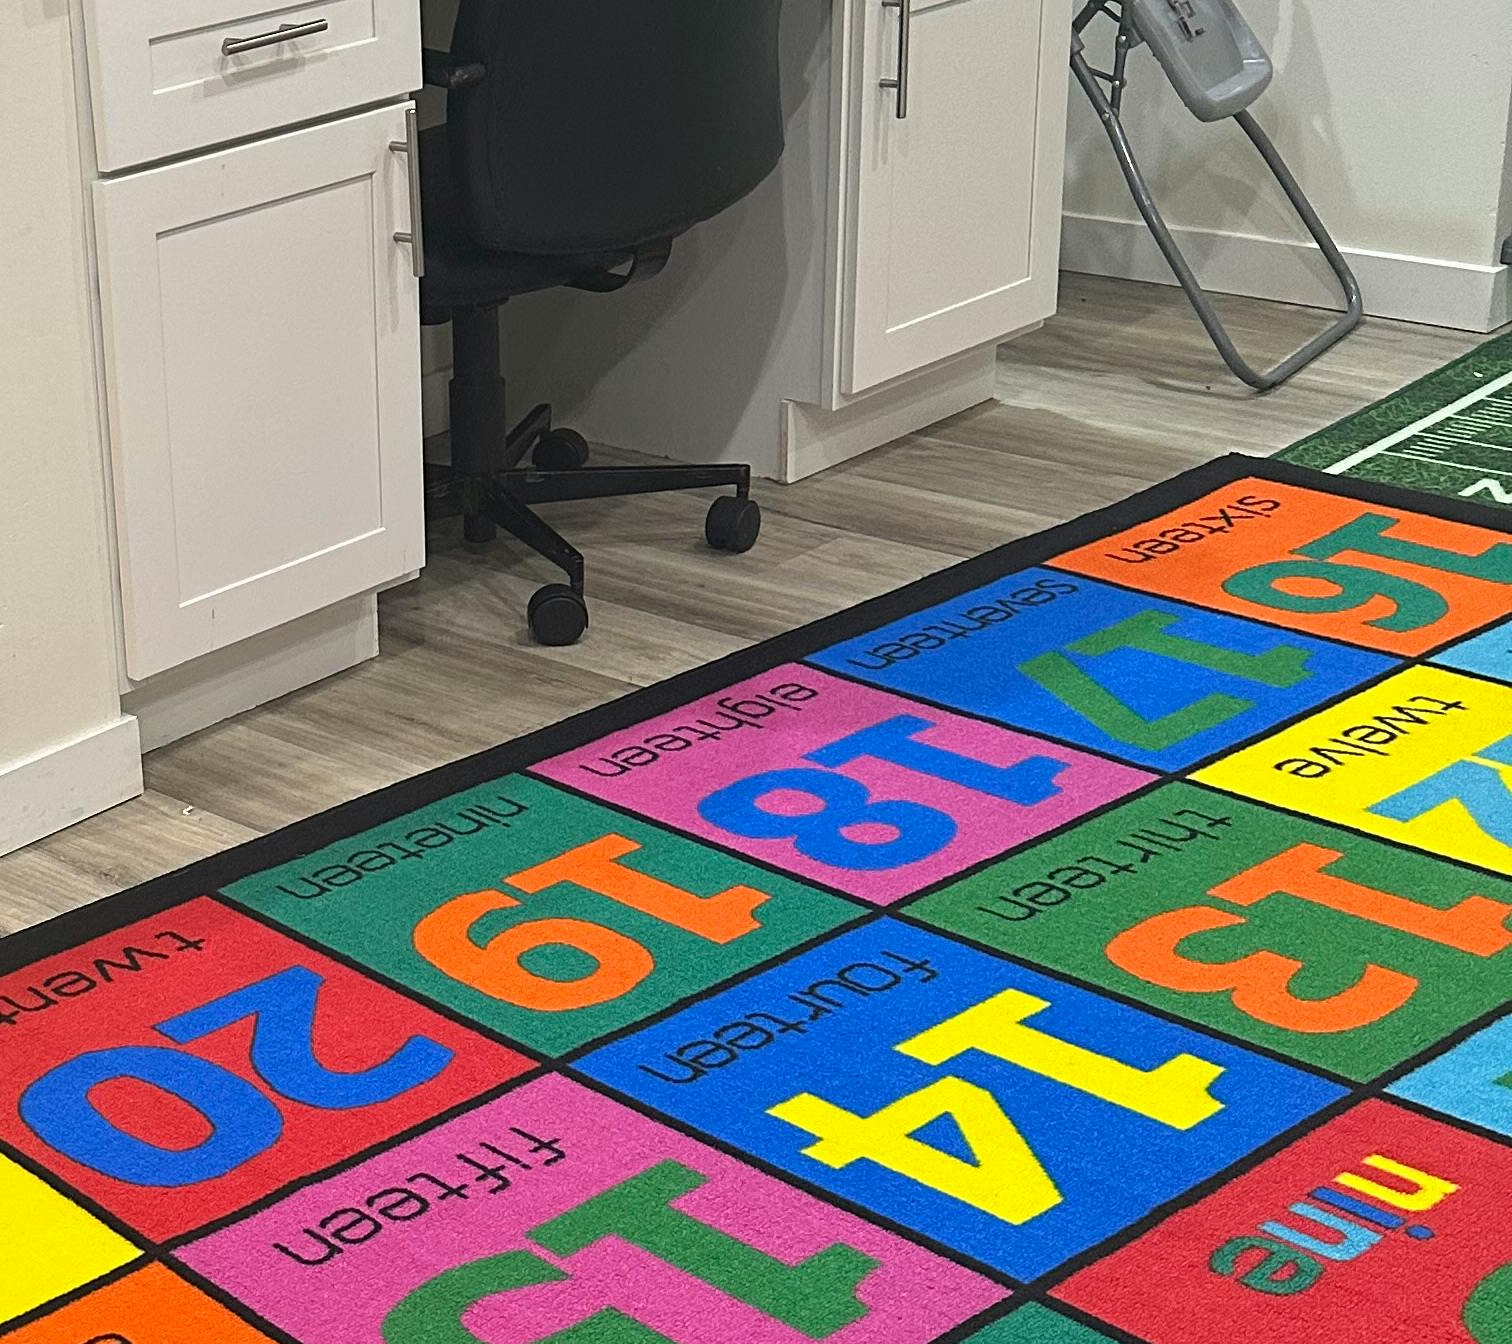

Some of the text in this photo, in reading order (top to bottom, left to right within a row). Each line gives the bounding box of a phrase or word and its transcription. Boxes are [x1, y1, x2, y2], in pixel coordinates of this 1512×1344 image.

[1105, 494, 1282, 565] sixteen
[1222, 512, 1512, 632] 16
[845, 578, 1081, 672] seventeen
[1017, 609, 1319, 753] 17
[581, 680, 820, 778] eighteen
[697, 713, 1072, 872] 18
[1272, 696, 1471, 780] twelve
[276, 794, 529, 900] nineteen
[977, 808, 1237, 924] thirteen
[412, 834, 773, 1012] 19
[1105, 841, 1512, 1034] 13
[18, 965, 456, 1188] 20
[638, 948, 939, 1085] fourteen
[766, 987, 1227, 1225] 14
[274, 1127, 567, 1267] fifteen
[1207, 1152, 1460, 1296] nine
